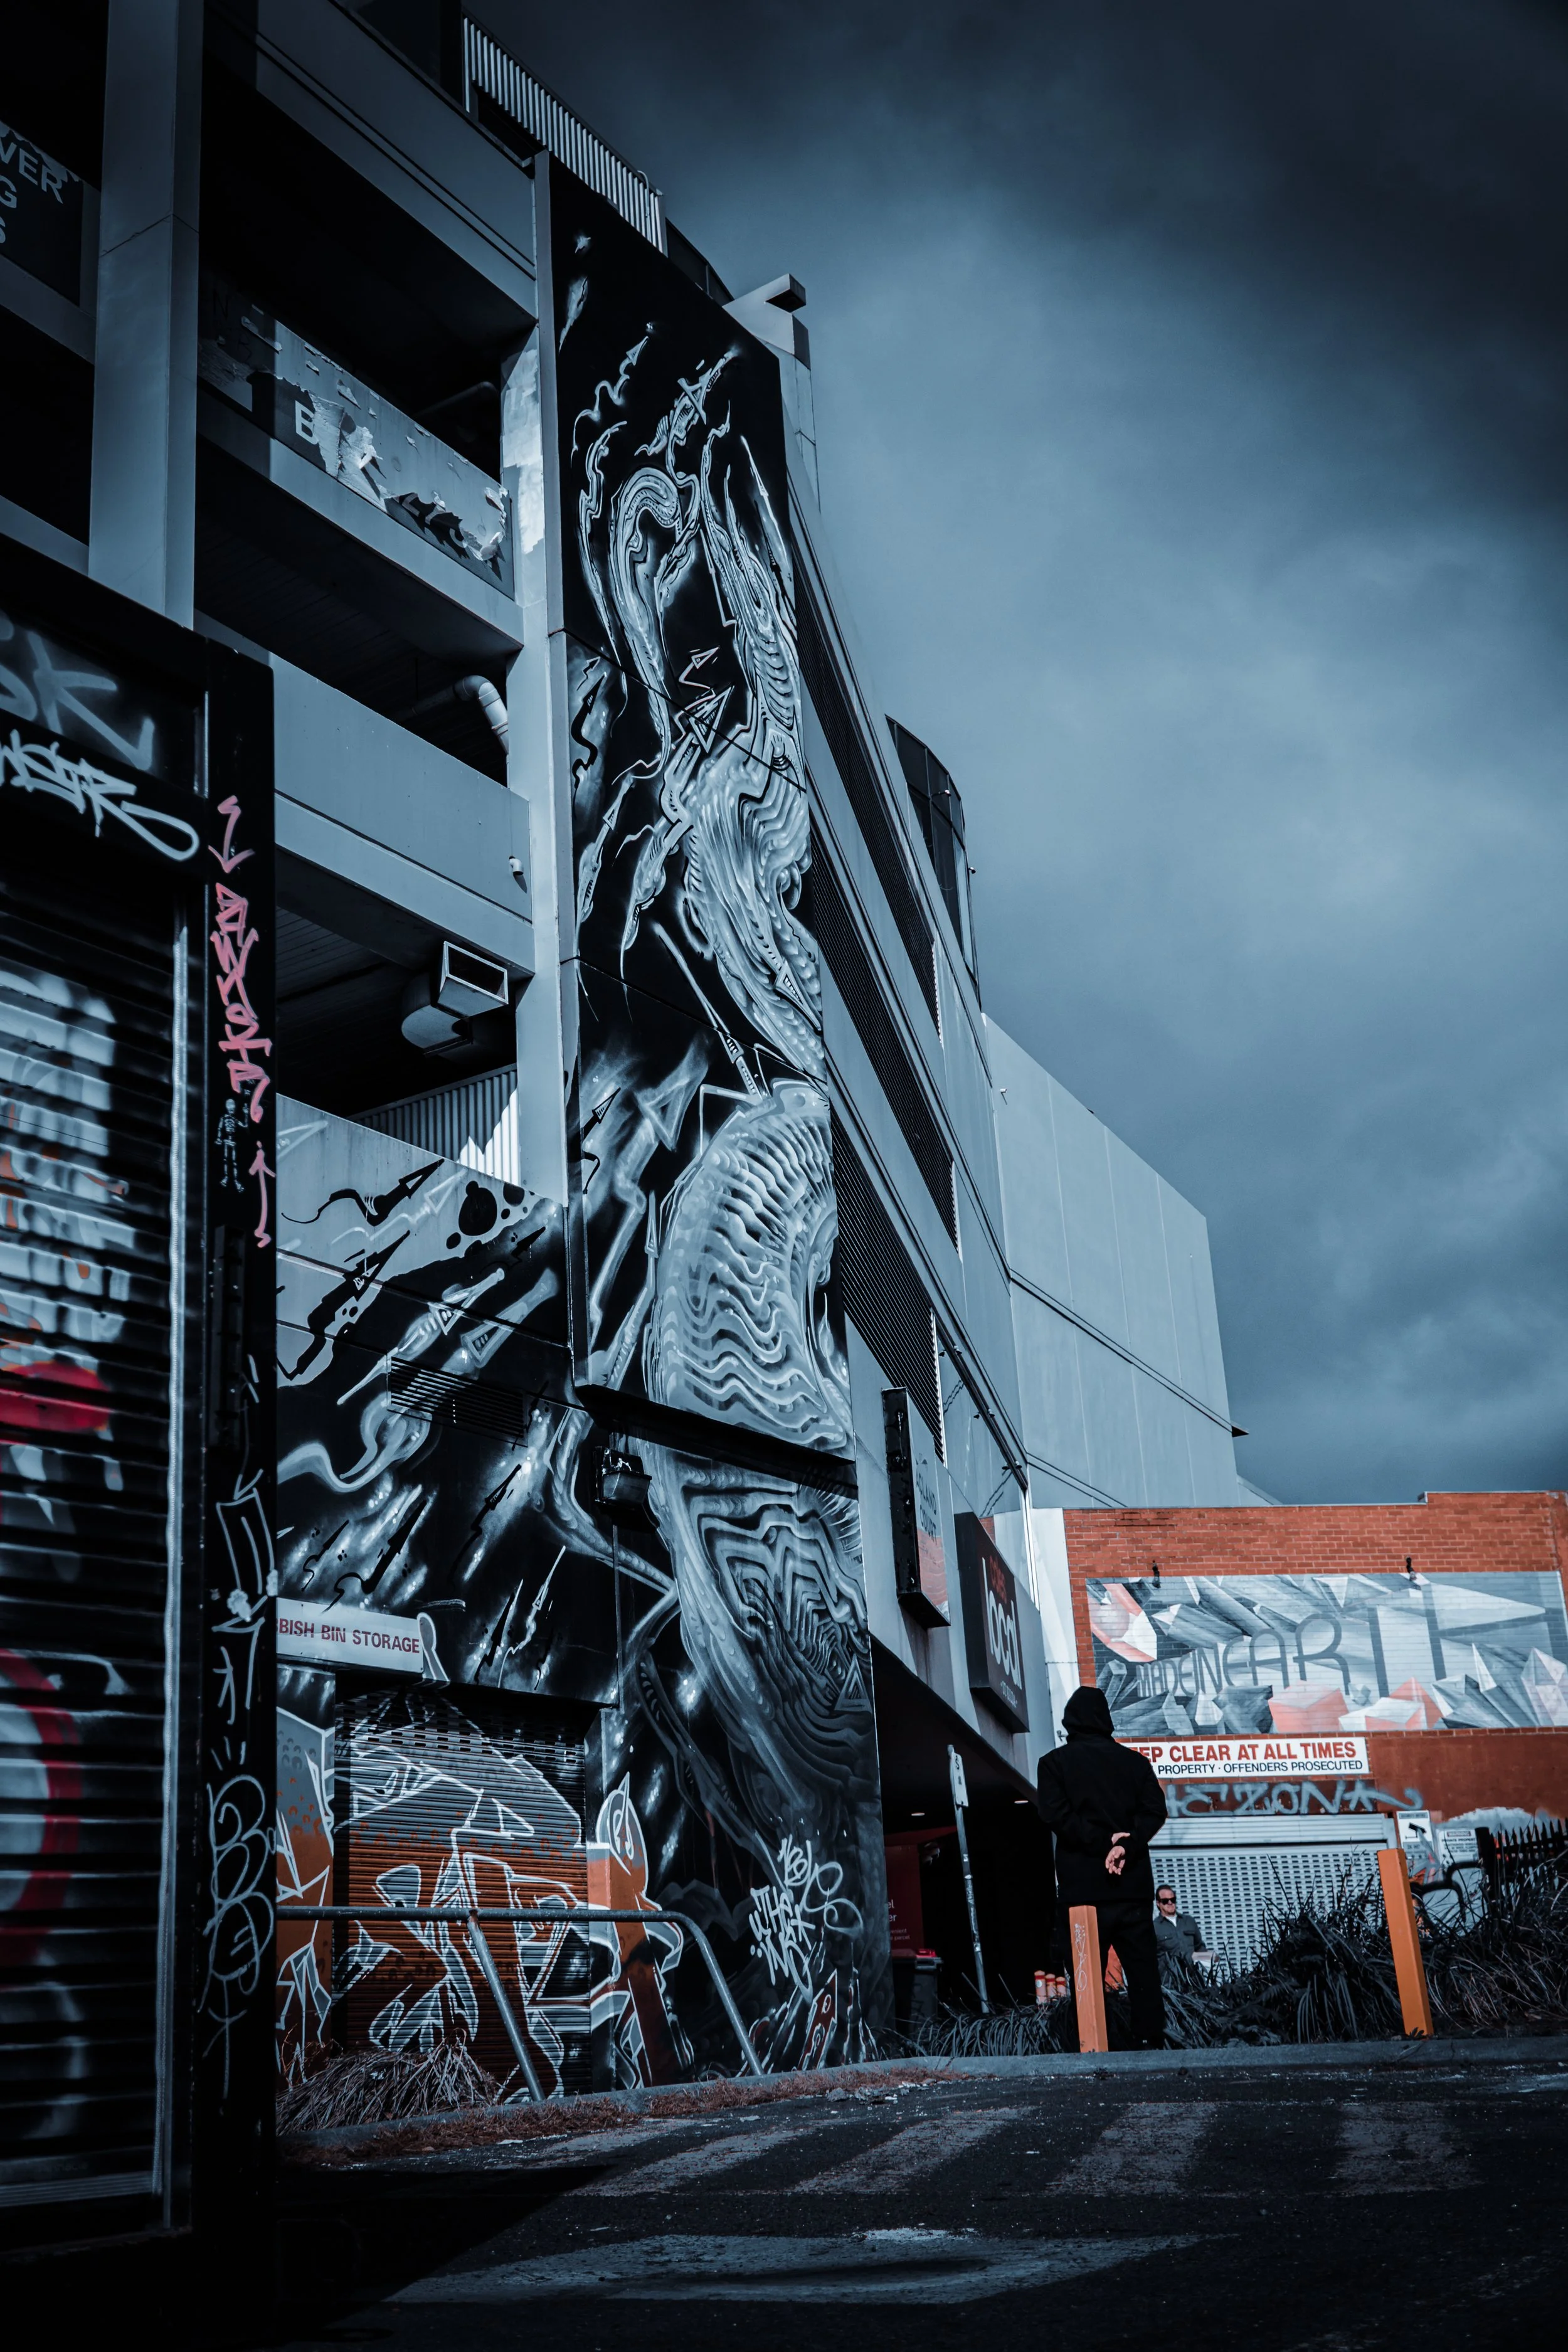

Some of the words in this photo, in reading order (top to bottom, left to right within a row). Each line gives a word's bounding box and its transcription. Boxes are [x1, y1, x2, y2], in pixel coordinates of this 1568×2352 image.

[276, 1618, 314, 1638] BISH
[321, 1624, 346, 1643] BIN
[352, 1629, 420, 1653] STORAGE
[982, 1557, 1022, 1690] local
[1169, 1744, 1231, 1762] CLEAR
[1237, 1744, 1259, 1761] AT
[1264, 1743, 1298, 1760] ALL
[1300, 1741, 1357, 1759] TIMES
[1158, 1763, 1216, 1774] PROPERTY
[1223, 1761, 1288, 1773] OFFENDERS
[1291, 1760, 1363, 1771] PROSECUTED
